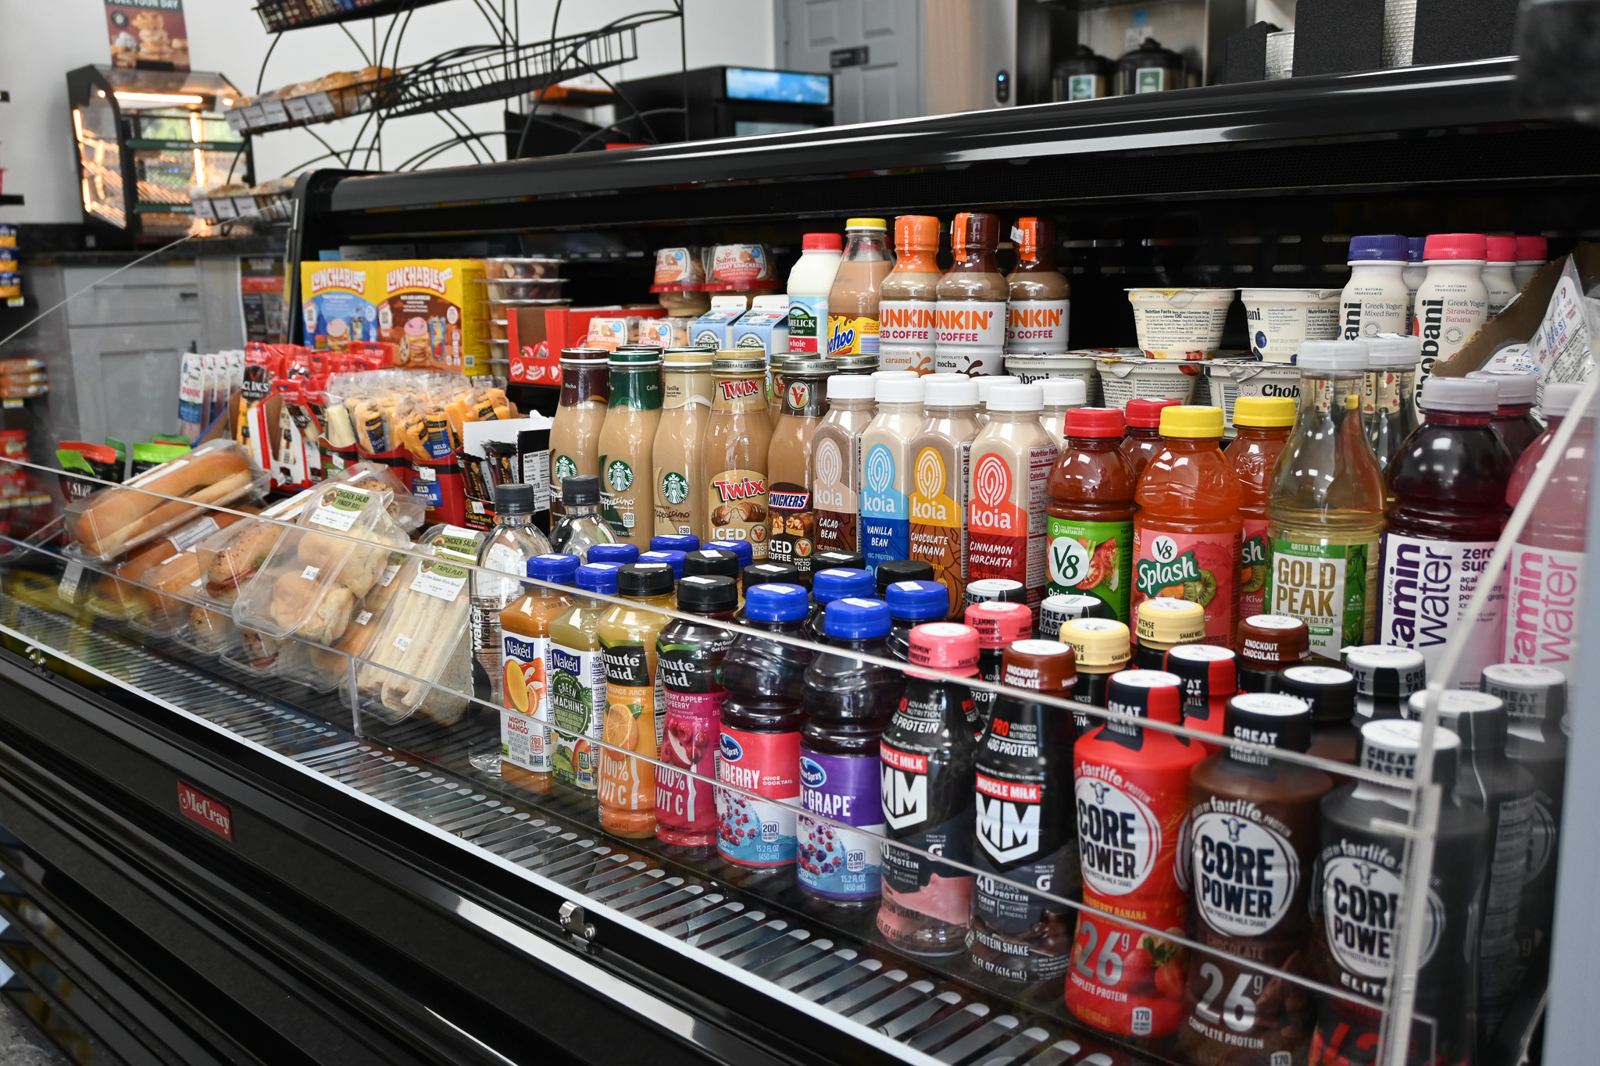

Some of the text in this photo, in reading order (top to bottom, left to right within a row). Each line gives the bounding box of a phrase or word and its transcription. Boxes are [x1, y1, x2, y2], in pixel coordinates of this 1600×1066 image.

[880, 309, 936, 328] UNKIN
[1446, 308, 1480, 316] Strawberry
[892, 331, 928, 340] COFFEE
[941, 332, 978, 341] COFFEE
[1017, 330, 1053, 339] COFFEE
[815, 484, 843, 507] koia
[863, 492, 896, 513] koia
[912, 496, 946, 521] koia
[971, 504, 1011, 529] koia
[819, 517, 838, 529] CACAO
[866, 526, 893, 537] VANILLA
[712, 528, 747, 540] ICED
[821, 530, 837, 540] BEAN
[871, 537, 888, 547] BEAN
[910, 532, 949, 545] CHOCOLATE
[912, 545, 945, 557] BANANA
[969, 541, 1013, 555] CINNAMON
[1155, 539, 1172, 559] V8
[969, 555, 1013, 568] HORCHATA
[1053, 544, 1080, 580] V8
[1138, 557, 1198, 594] Splash
[1277, 557, 1336, 590] GOLD
[1276, 585, 1334, 617] PEAK
[1419, 546, 1452, 647] water
[1540, 556, 1578, 664] water
[507, 640, 531, 659] Naked
[1244, 638, 1278, 651] KNOCKOUT
[553, 656, 579, 673] Naked
[601, 649, 640, 667] inute
[659, 656, 695, 672] nute
[1243, 649, 1280, 662] CHOCOLATE
[1007, 664, 1039, 678] KNOCKOUT
[558, 683, 577, 698] GREEN
[1004, 674, 1040, 689] CHOCOLATE
[554, 696, 584, 715] MACHINE
[907, 708, 941, 719] NUTRITION
[908, 700, 943, 711] ADVANCED
[1108, 700, 1141, 717] GREAT
[897, 717, 939, 733] PROTEIN
[992, 717, 1037, 736] PRO ADVANCED
[1009, 731, 1037, 740] NUTRITION
[1234, 726, 1277, 743] GREAT
[999, 741, 1038, 757] PROTEIN
[1367, 746, 1416, 766] GREAT
[603, 756, 629, 782] 100%
[900, 753, 924, 771] MILK
[1367, 760, 1414, 779] TASTE
[657, 765, 685, 791] 100%
[601, 780, 627, 806] VIT C
[976, 775, 1037, 800] MUSCLE MILK
[657, 786, 684, 816] VIT C
[762, 824, 777, 833] 200
[1077, 798, 1136, 849] CORE
[848, 852, 863, 862] 200
[889, 856, 919, 870] PROTEIN
[1080, 839, 1137, 880] POWER
[1200, 834, 1274, 888] CORE
[977, 875, 994, 895] 40
[1036, 875, 1050, 891] G
[994, 890, 1029, 902] PROTEIN
[1201, 876, 1273, 919] POWER
[976, 931, 1029, 956] PROTEIN SHAKE
[1333, 915, 1390, 959] POWE
[985, 960, 995, 972] OZ
[995, 963, 1010, 978] (414
[1011, 970, 1028, 981] mL)
[1071, 971, 1128, 1003] COMPLETE PROTEIN
[1134, 1009, 1150, 1021] 170
[1188, 1016, 1264, 1049] COMPLETE PROTEIN
